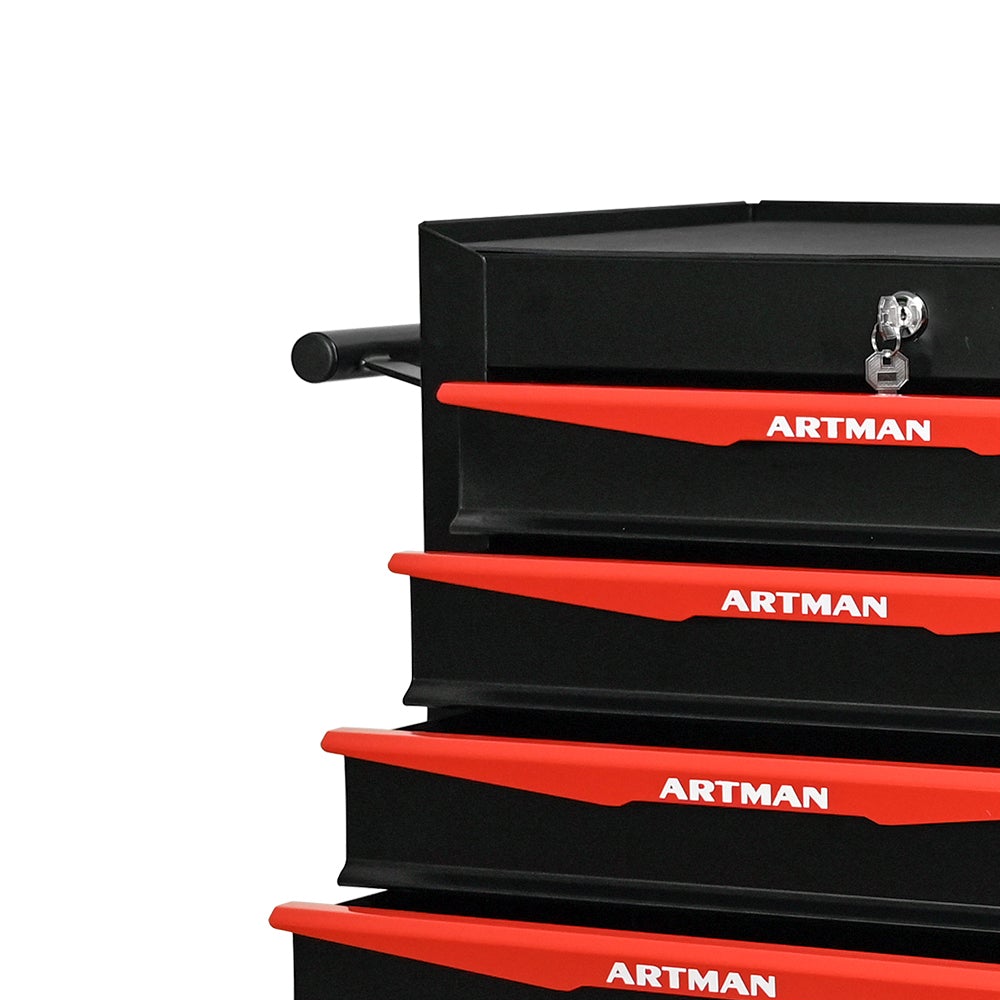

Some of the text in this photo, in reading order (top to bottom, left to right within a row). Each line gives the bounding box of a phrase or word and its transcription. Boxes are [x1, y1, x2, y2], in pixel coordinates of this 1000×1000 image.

[767, 416, 930, 441] ARTMAN
[722, 590, 887, 618] ARTMAN
[660, 778, 828, 809] ARTMAN
[607, 962, 776, 997] ARTMAN
